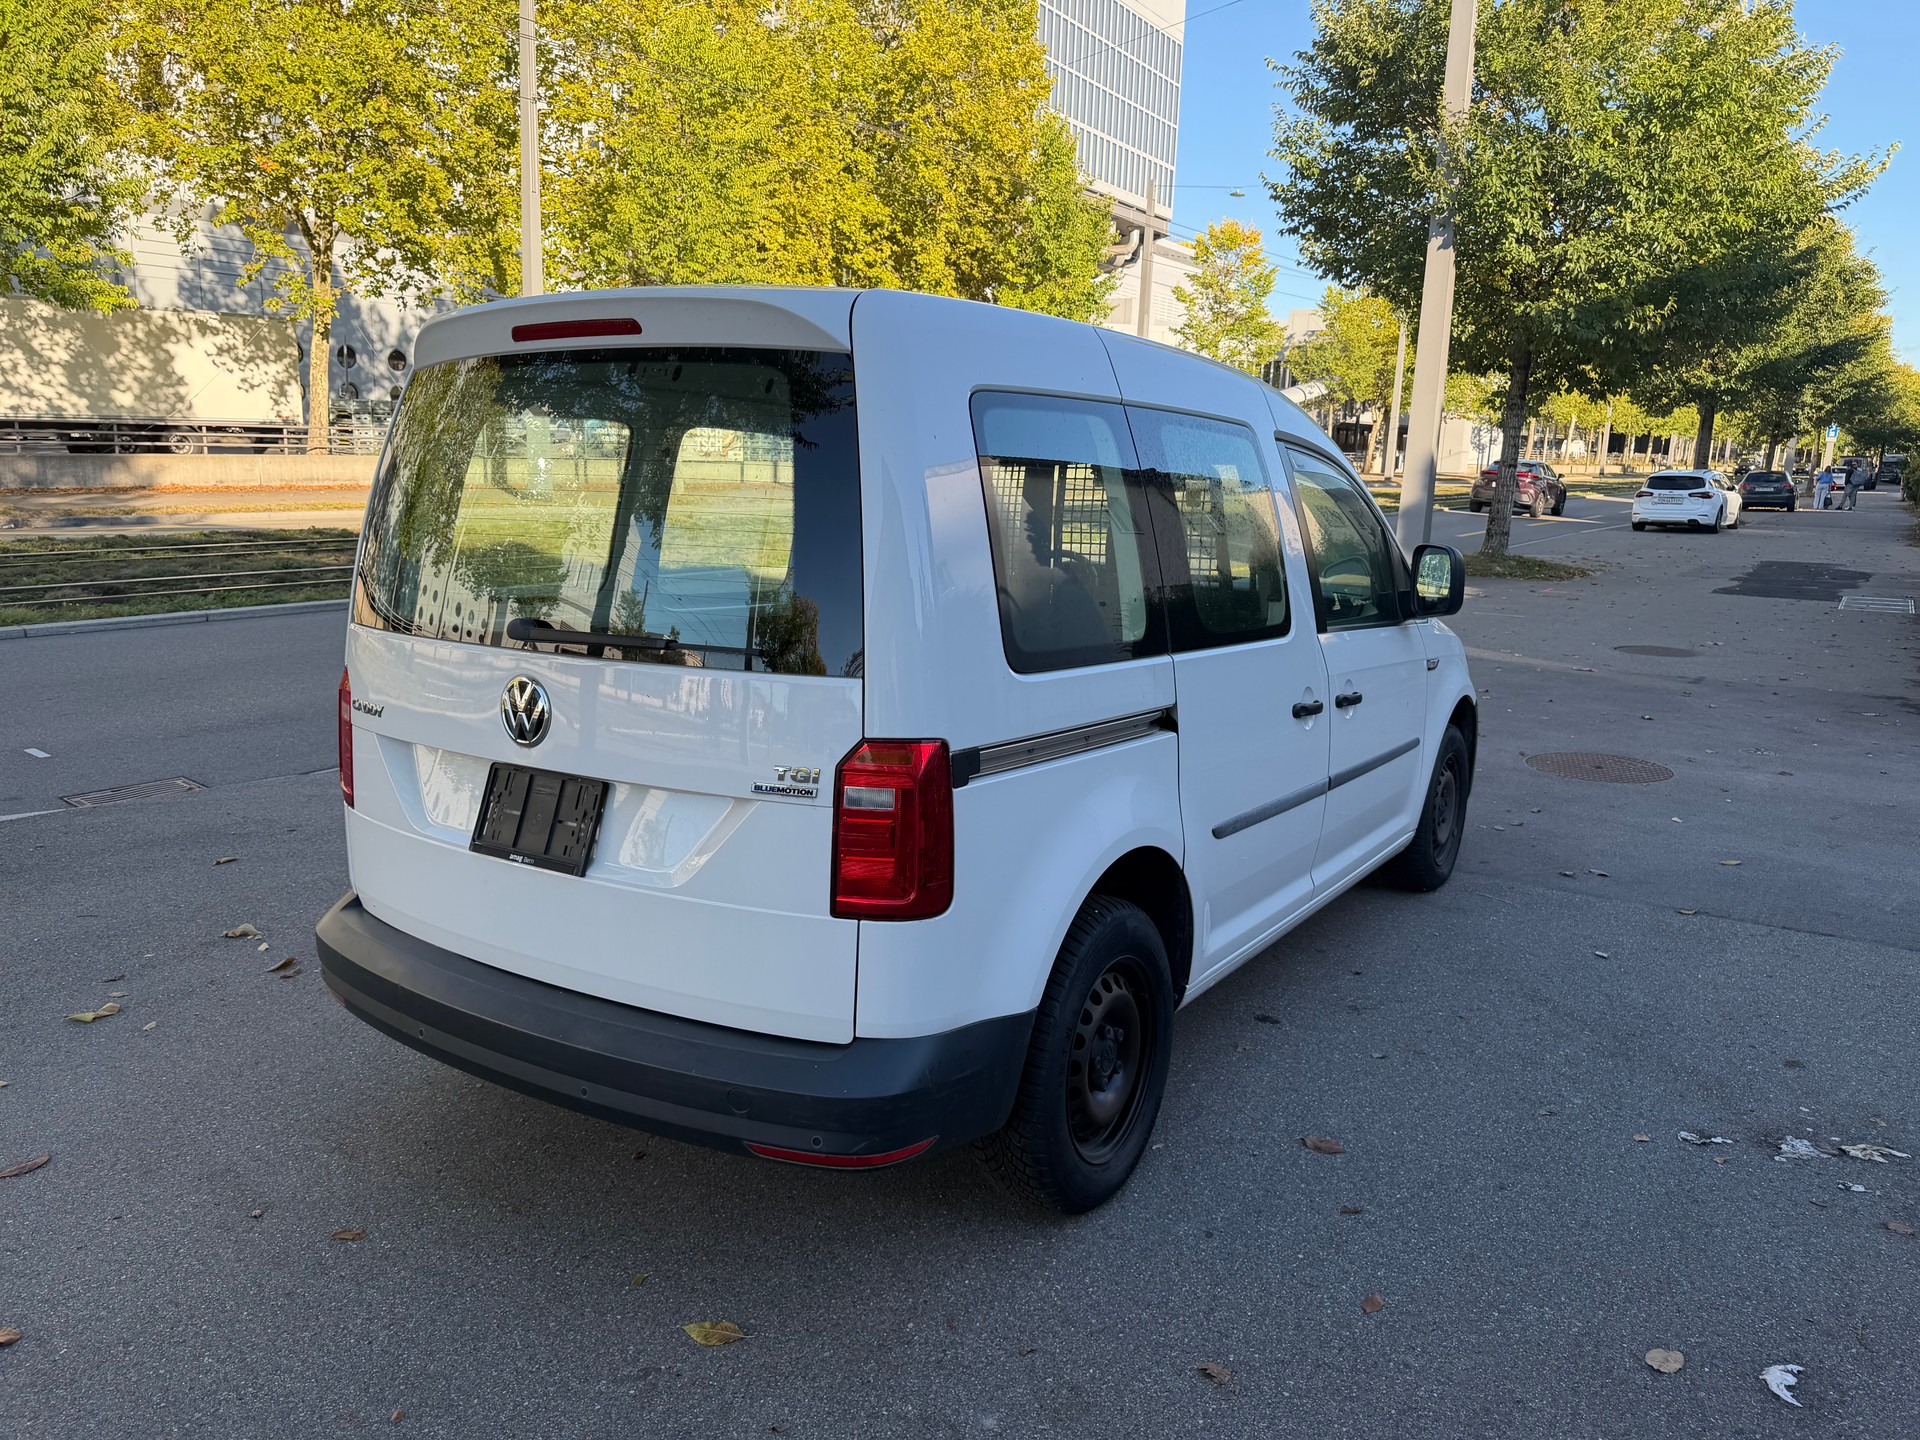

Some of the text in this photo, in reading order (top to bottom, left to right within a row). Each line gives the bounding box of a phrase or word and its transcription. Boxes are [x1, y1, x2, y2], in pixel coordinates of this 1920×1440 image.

[352, 698, 385, 718] CADDY
[773, 765, 821, 784] TGI
[754, 784, 814, 796] BLUEMOTION
[509, 854, 535, 864] amag Bern
